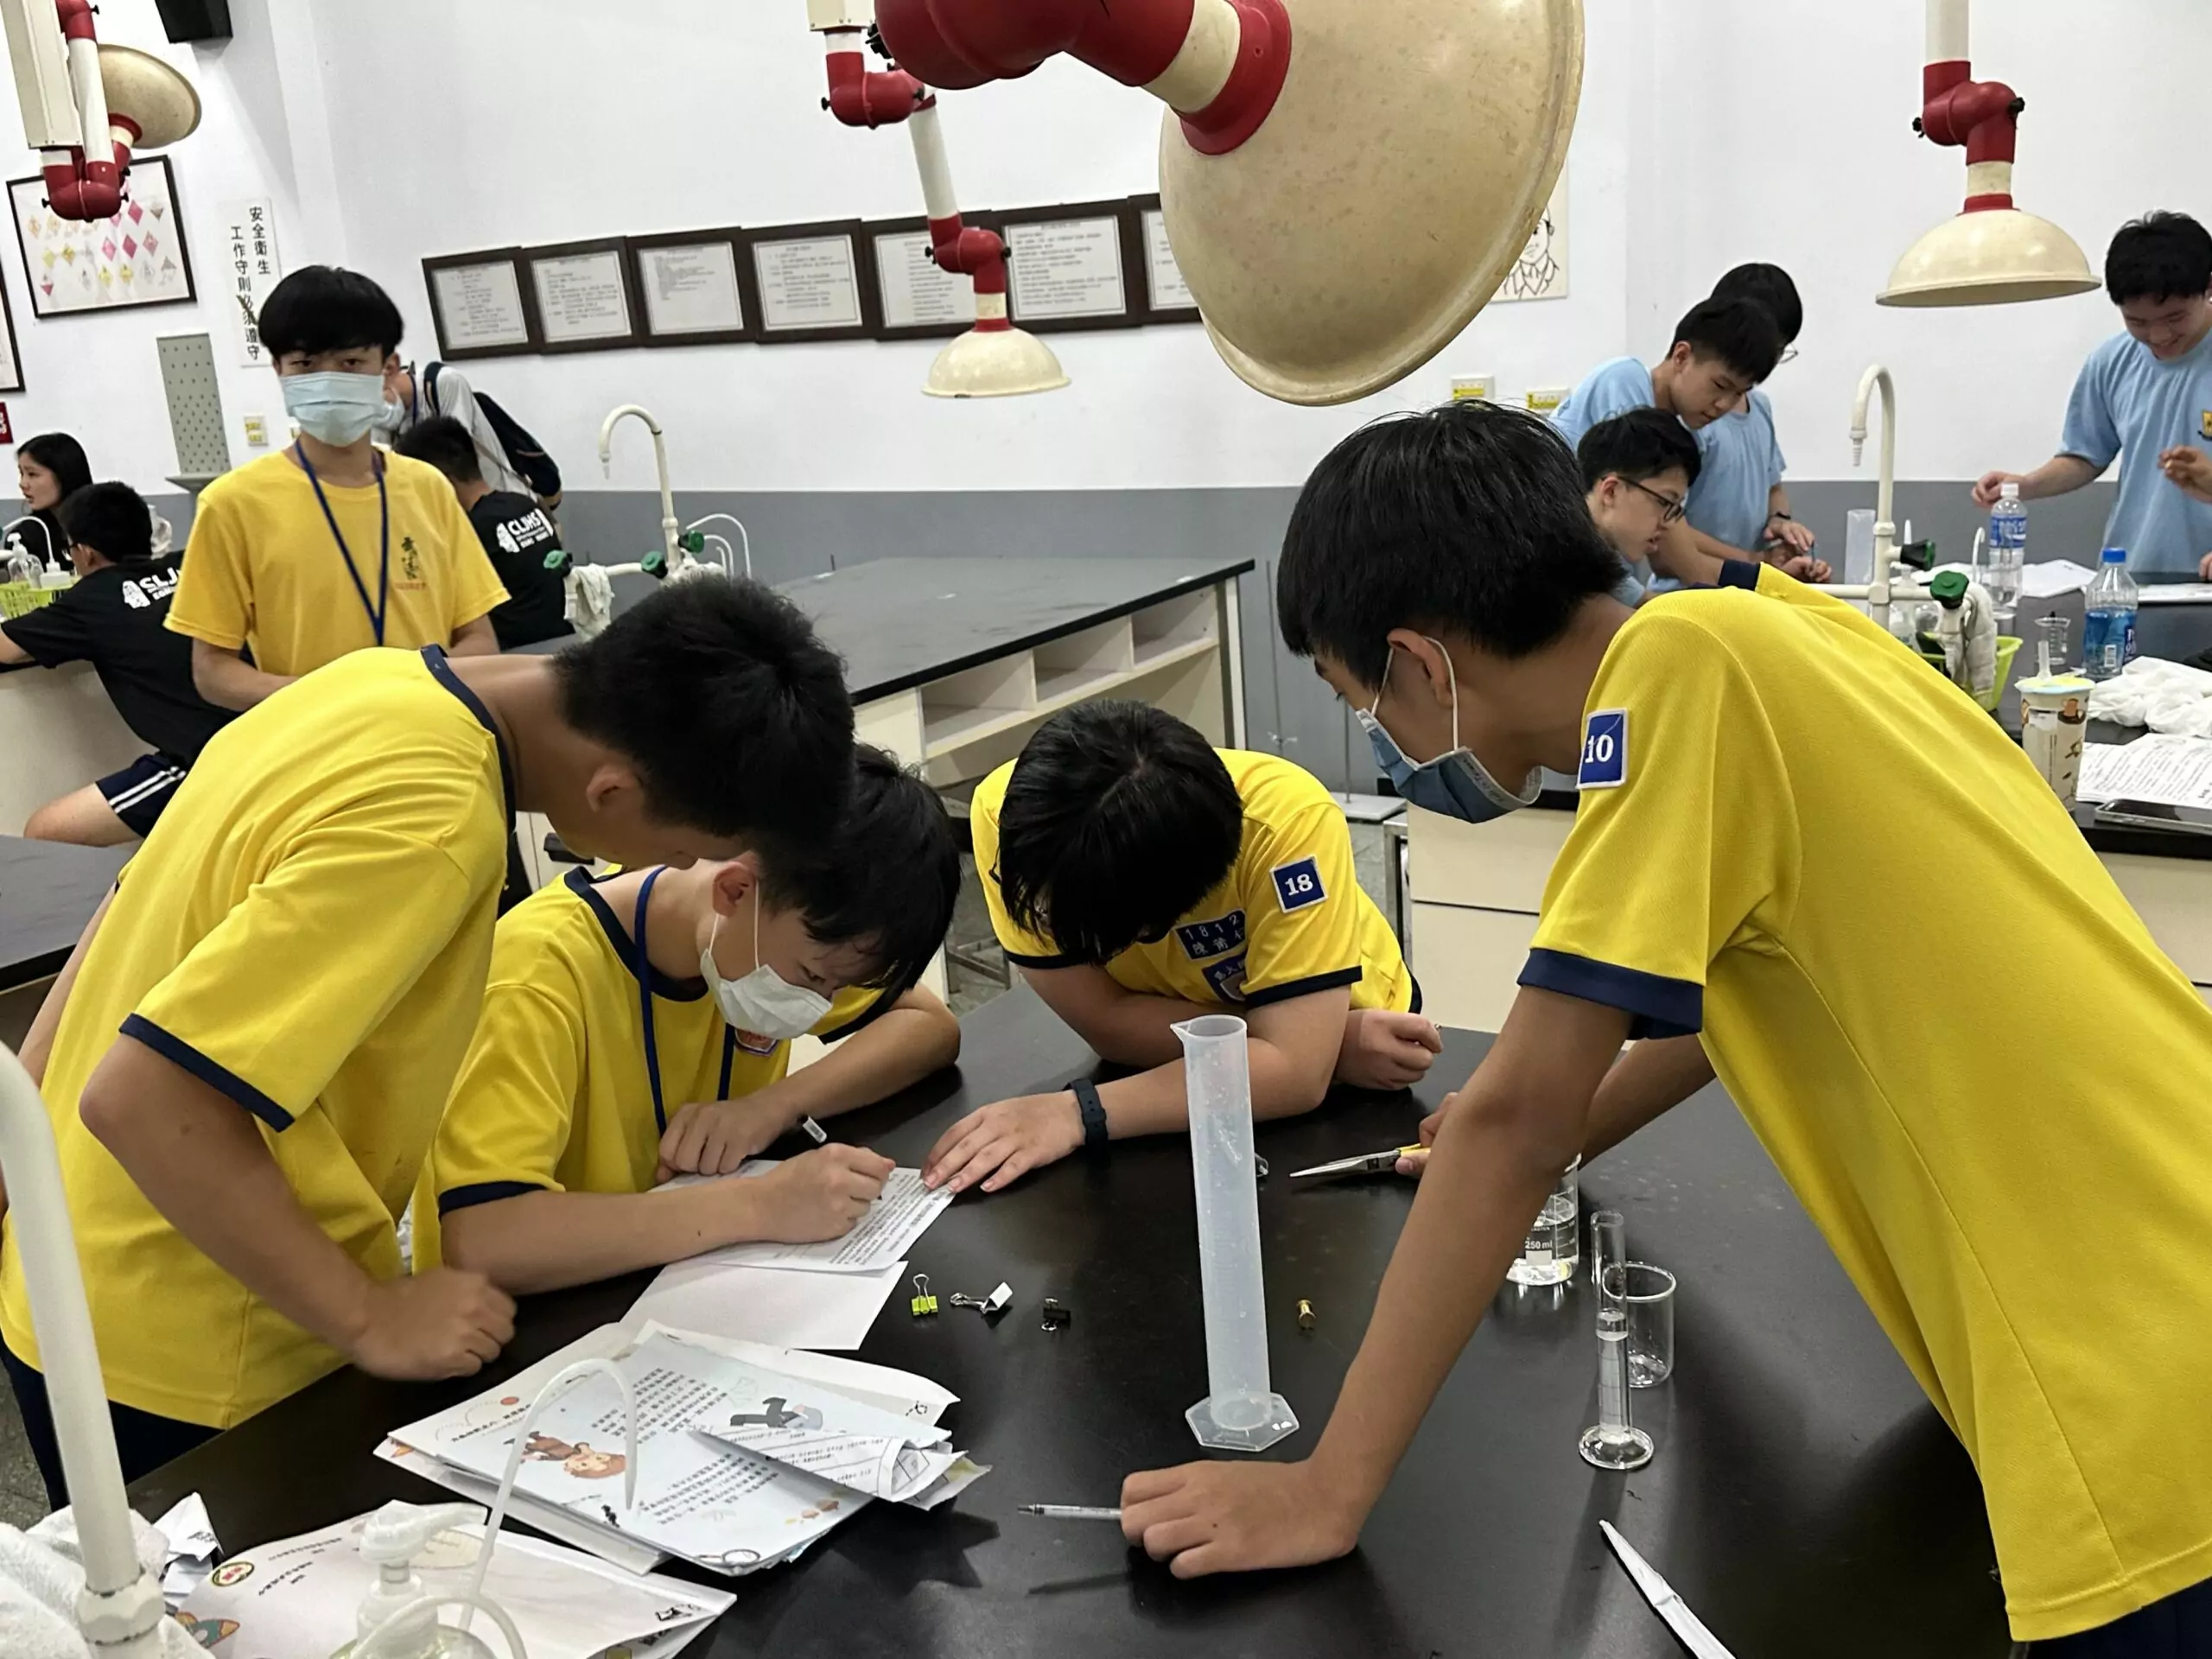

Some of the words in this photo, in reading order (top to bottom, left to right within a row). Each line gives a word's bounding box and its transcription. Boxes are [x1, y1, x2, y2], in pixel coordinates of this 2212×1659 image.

[249, 206, 271, 276] 安全衛生
[1285, 874, 1313, 896] 18
[1585, 1598, 1614, 1628] 10
